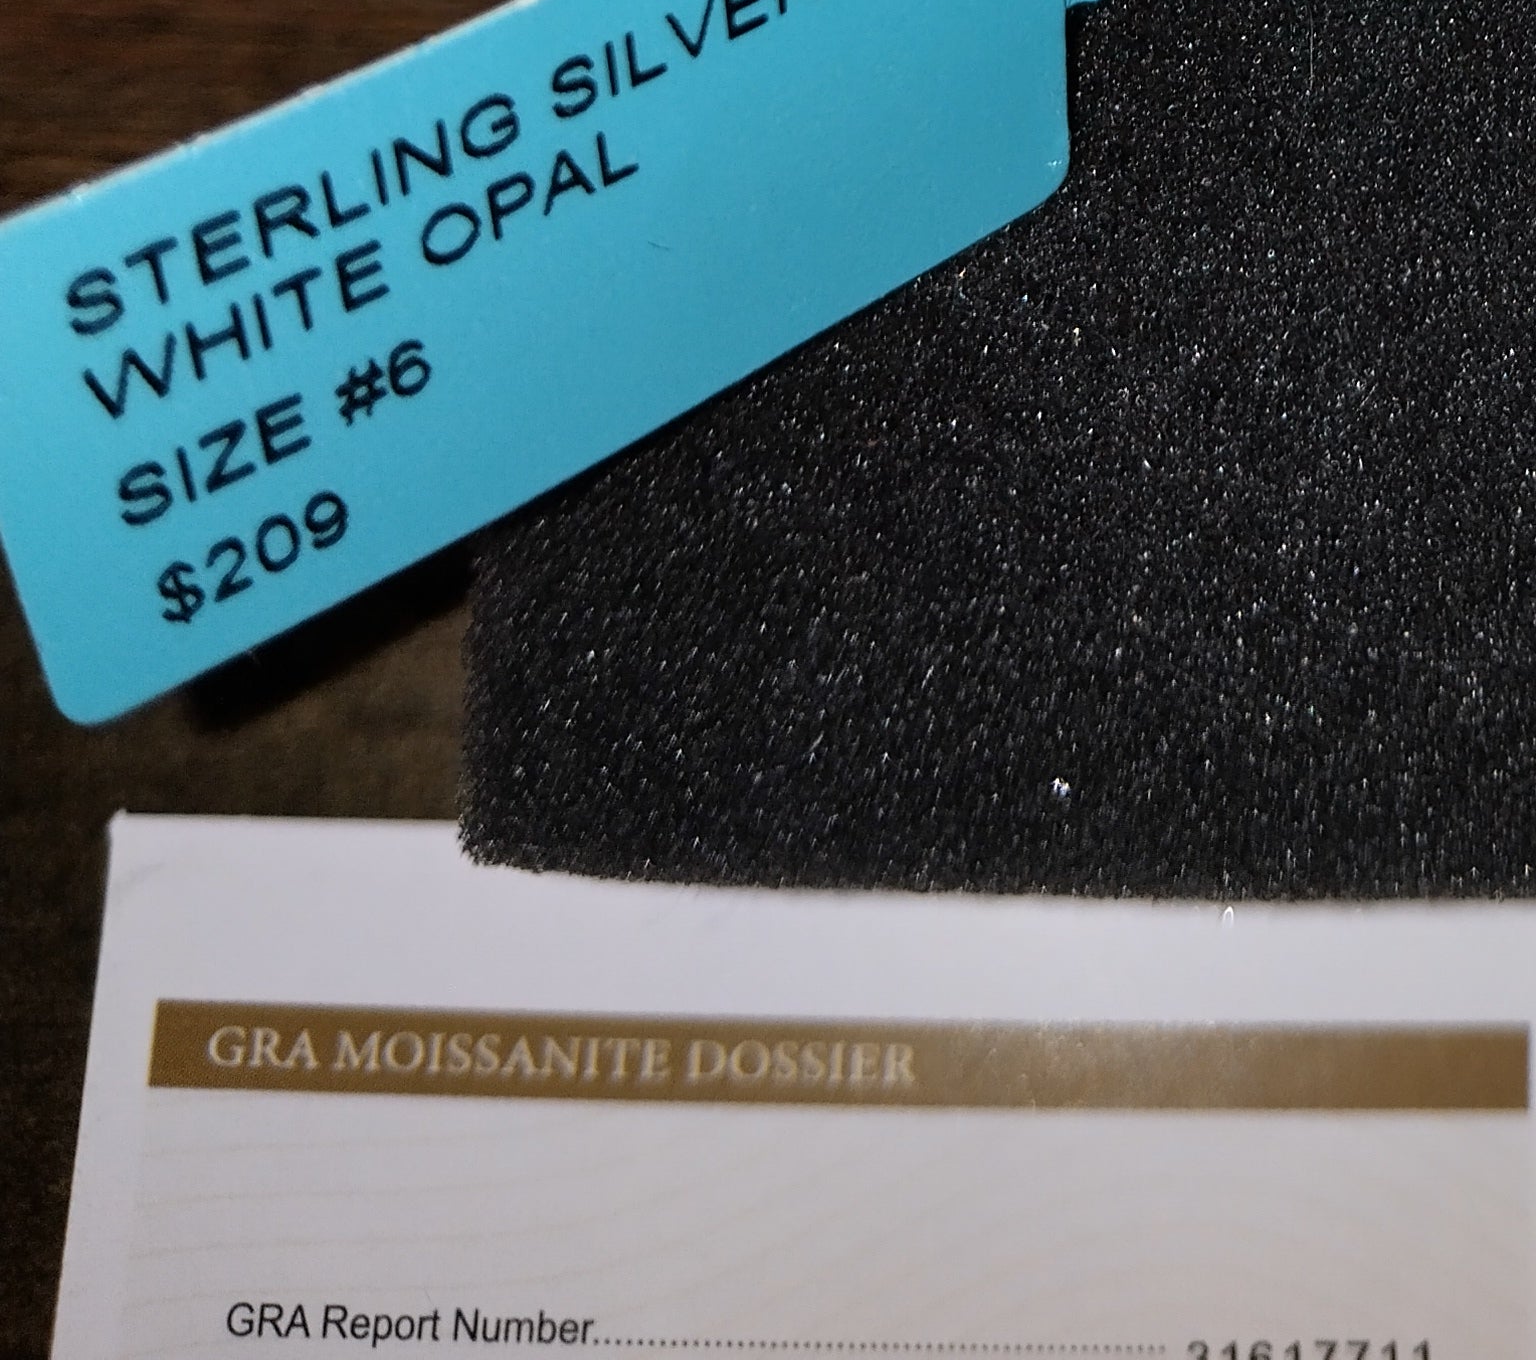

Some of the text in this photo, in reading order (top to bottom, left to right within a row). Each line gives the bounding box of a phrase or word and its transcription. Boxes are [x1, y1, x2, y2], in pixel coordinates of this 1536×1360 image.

[66, 93, 521, 336] STERLING
[82, 130, 641, 420] WHITE OPAL
[117, 338, 433, 526] SIZE #6
[156, 489, 350, 624] $209
[206, 1024, 916, 1086] GRA MOISSANITE DOSSIER
[225, 1300, 311, 1338] GRA
[321, 1303, 440, 1348] Report
